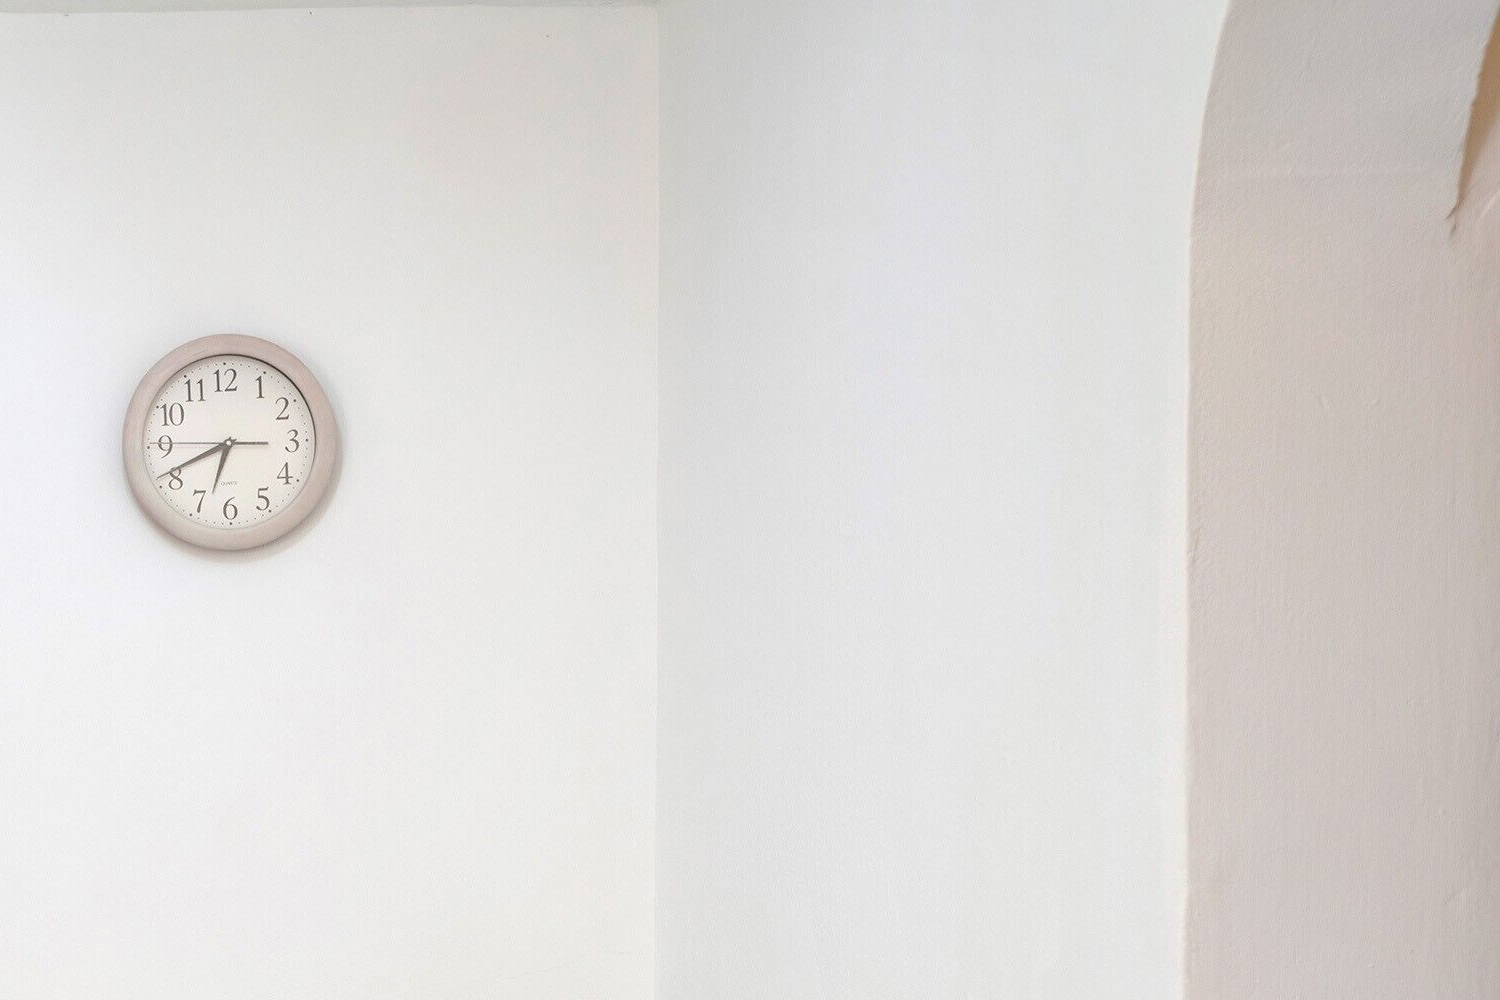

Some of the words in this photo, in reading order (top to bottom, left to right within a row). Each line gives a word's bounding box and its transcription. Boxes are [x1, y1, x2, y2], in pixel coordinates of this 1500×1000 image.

[185, 379, 206, 402] 11
[213, 368, 238, 392] 12
[254, 375, 265, 399] 1
[160, 402, 185, 427] 10
[275, 397, 290, 421] 2
[158, 435, 173, 459] 9
[284, 429, 300, 453] 3
[168, 467, 184, 491] 8
[276, 462, 293, 485] 4
[192, 489, 207, 513] 7
[222, 496, 238, 520] 6
[255, 487, 270, 511] 5
